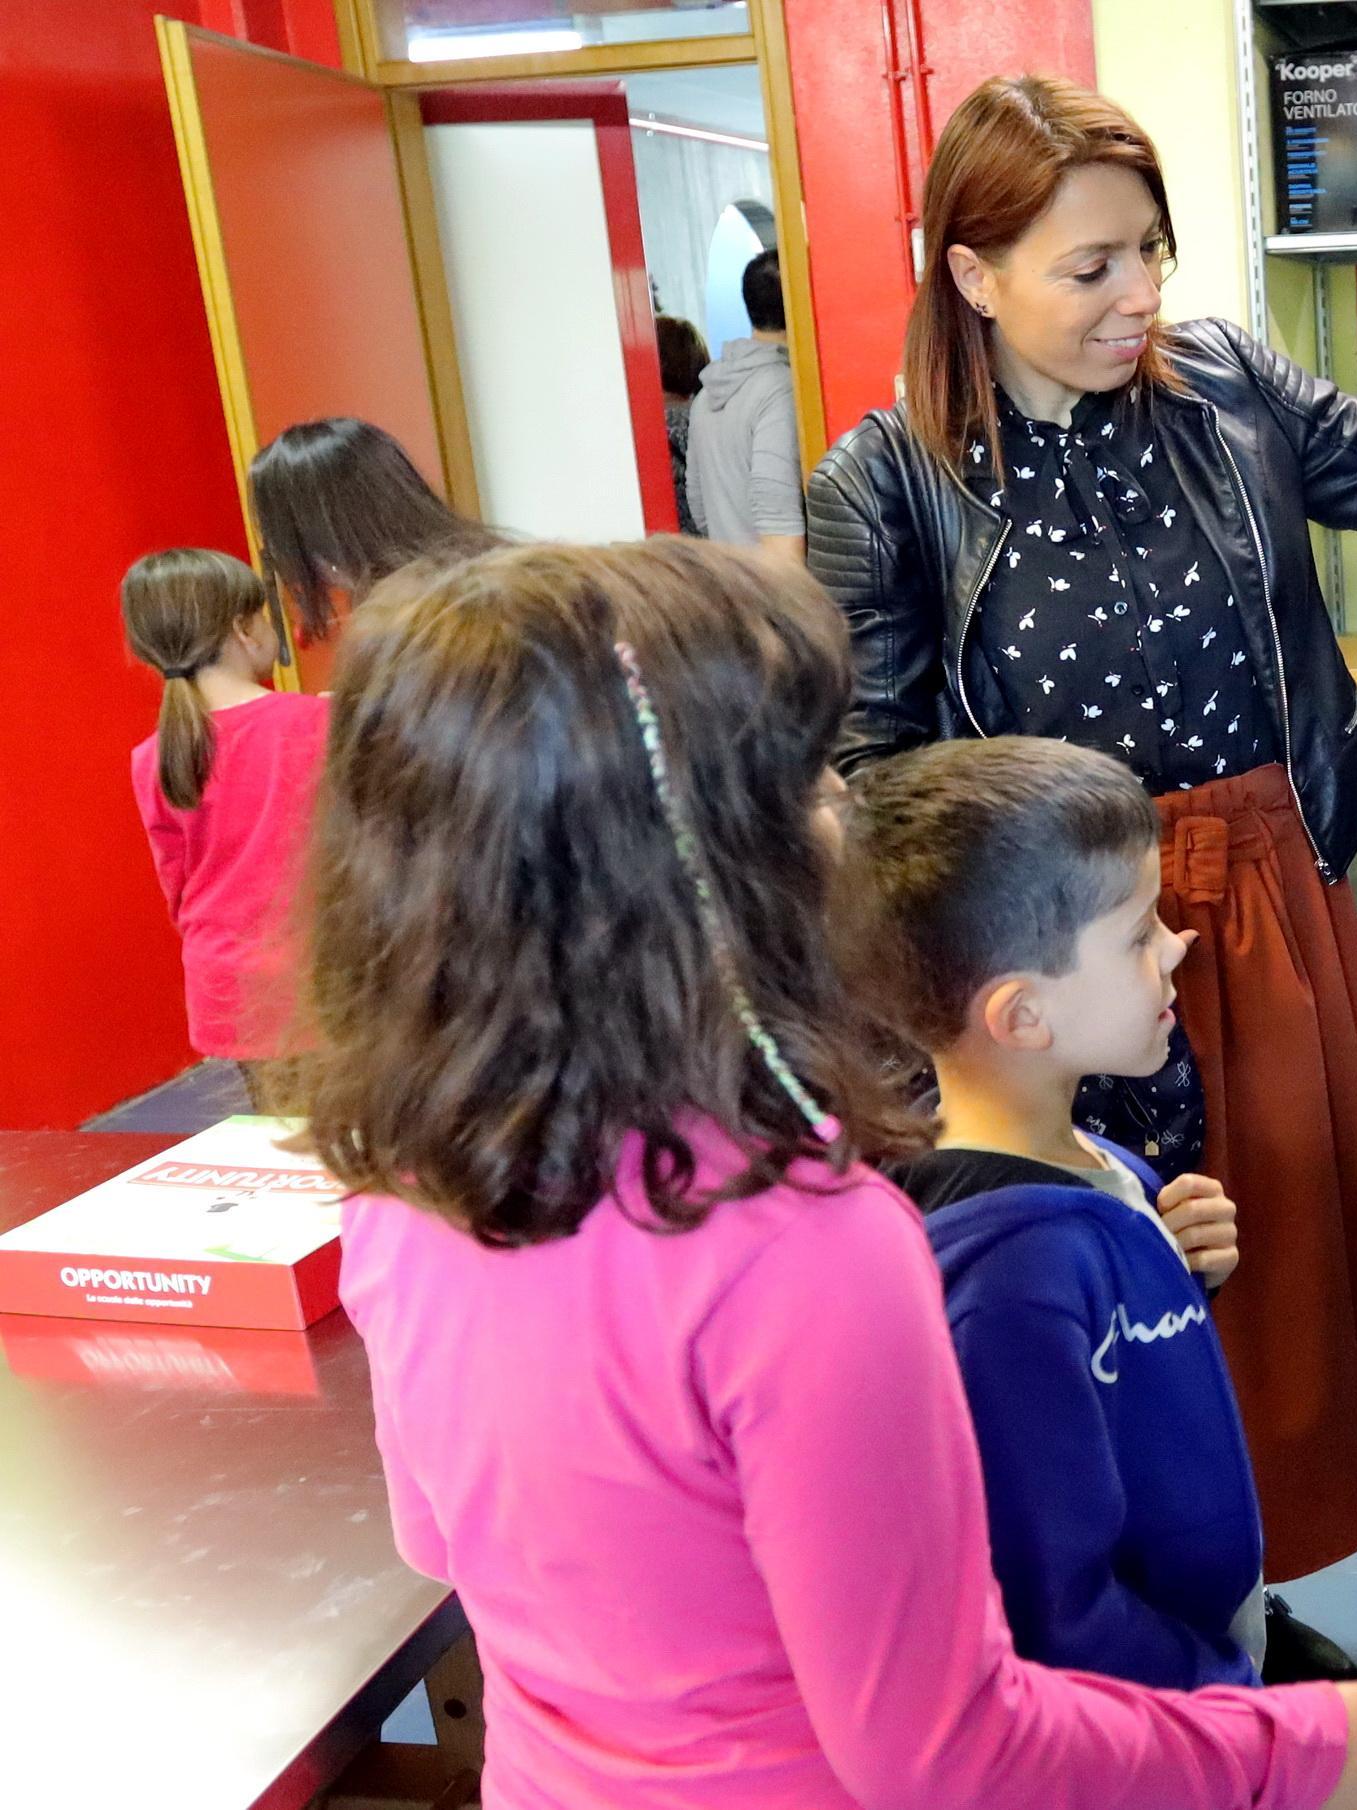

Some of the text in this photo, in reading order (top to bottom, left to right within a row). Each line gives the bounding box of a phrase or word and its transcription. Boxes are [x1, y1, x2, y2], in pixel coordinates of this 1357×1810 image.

[1279, 62, 1355, 83] Kooper
[1283, 88, 1338, 105] FORNO
[143, 1165, 346, 1192] PORTUNITY
[60, 1266, 212, 1295] OPPORTUNITY
